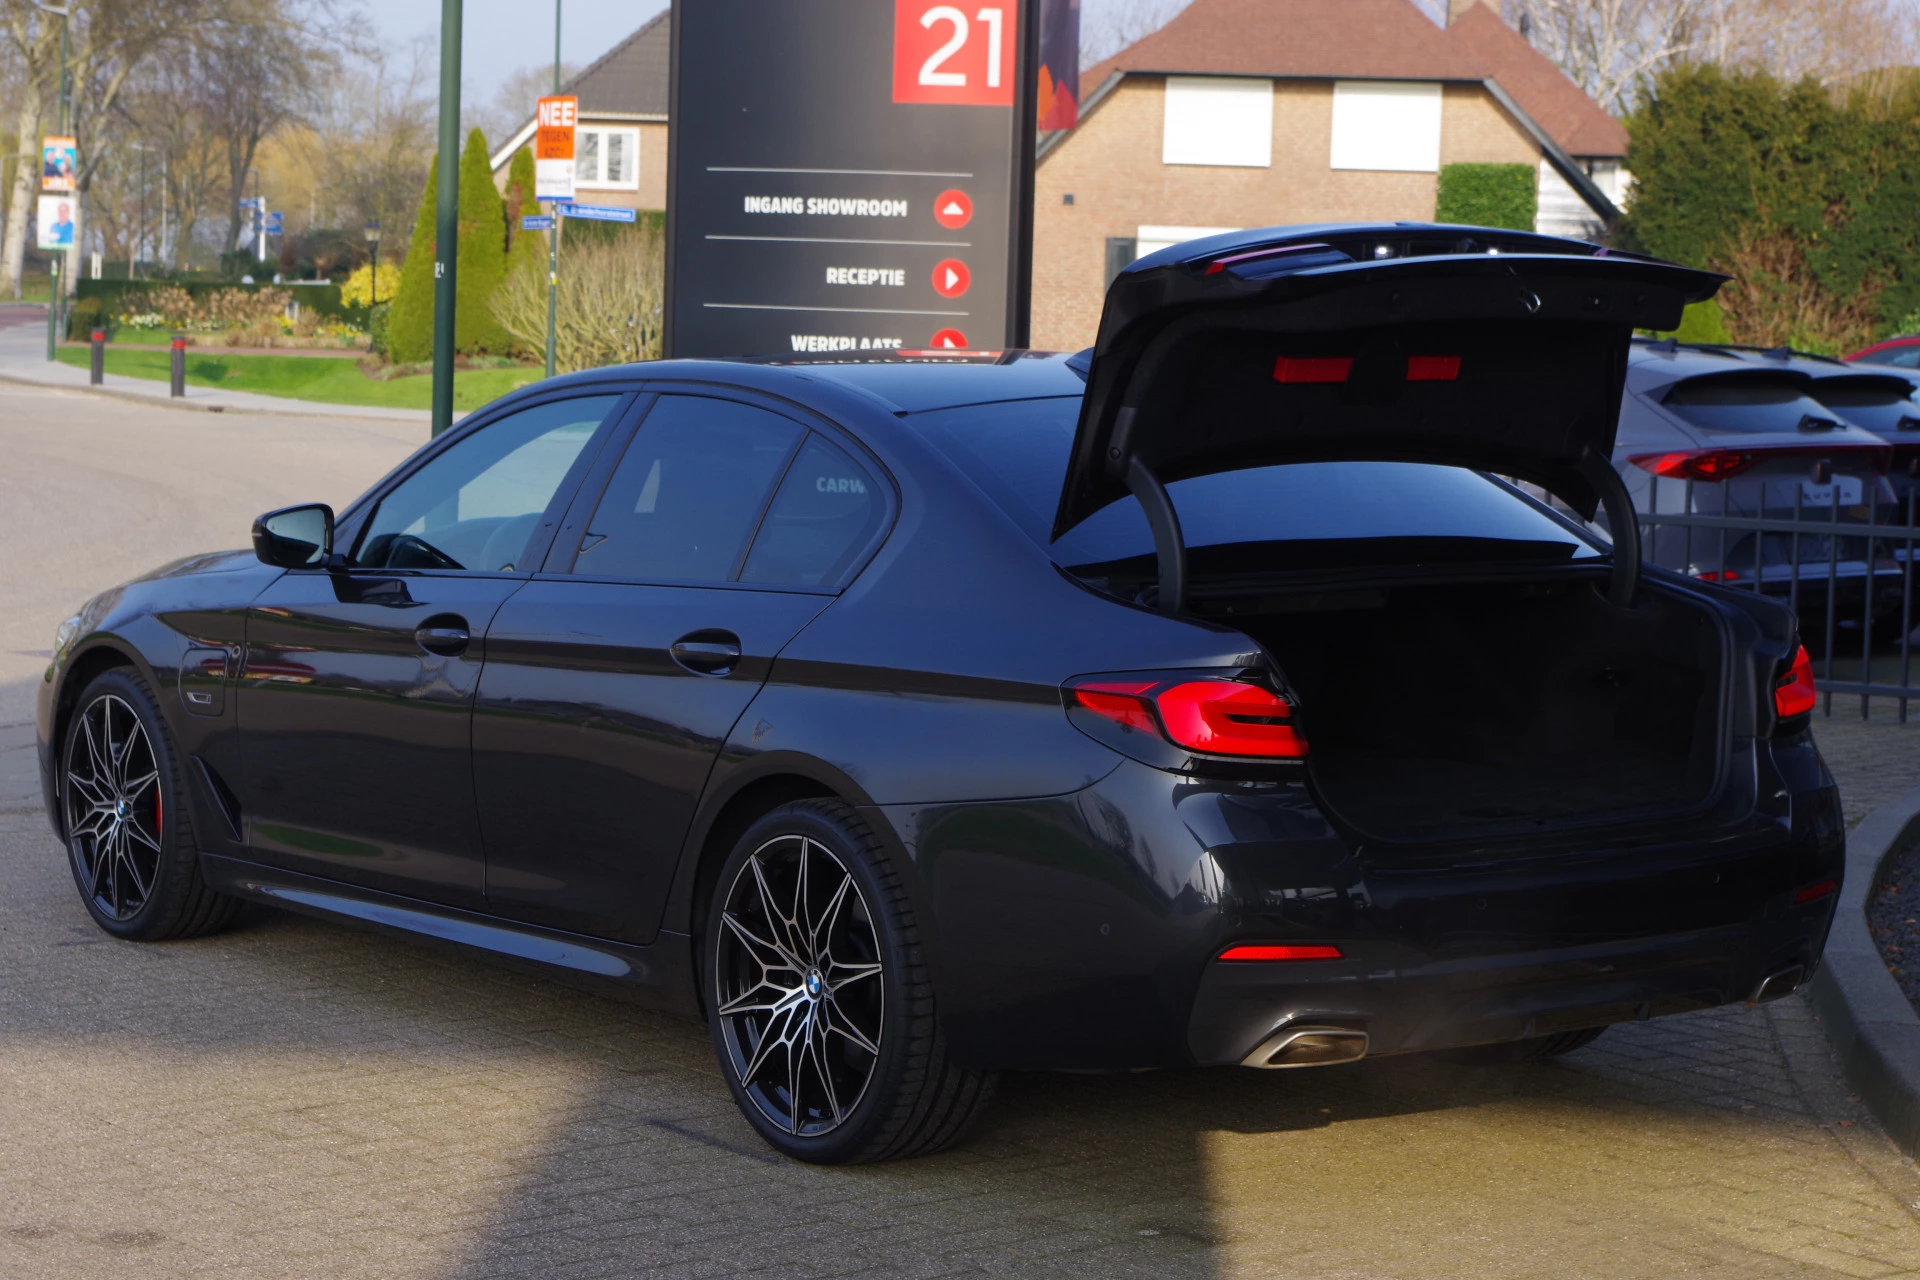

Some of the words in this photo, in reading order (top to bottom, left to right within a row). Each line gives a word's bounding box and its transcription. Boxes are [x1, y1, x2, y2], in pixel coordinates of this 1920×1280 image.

[918, 5, 1003, 88] 21
[539, 101, 575, 126] NEE
[744, 196, 804, 214] INGANG
[806, 198, 908, 217] SHOWROOM
[826, 267, 905, 286] RECEPTIE
